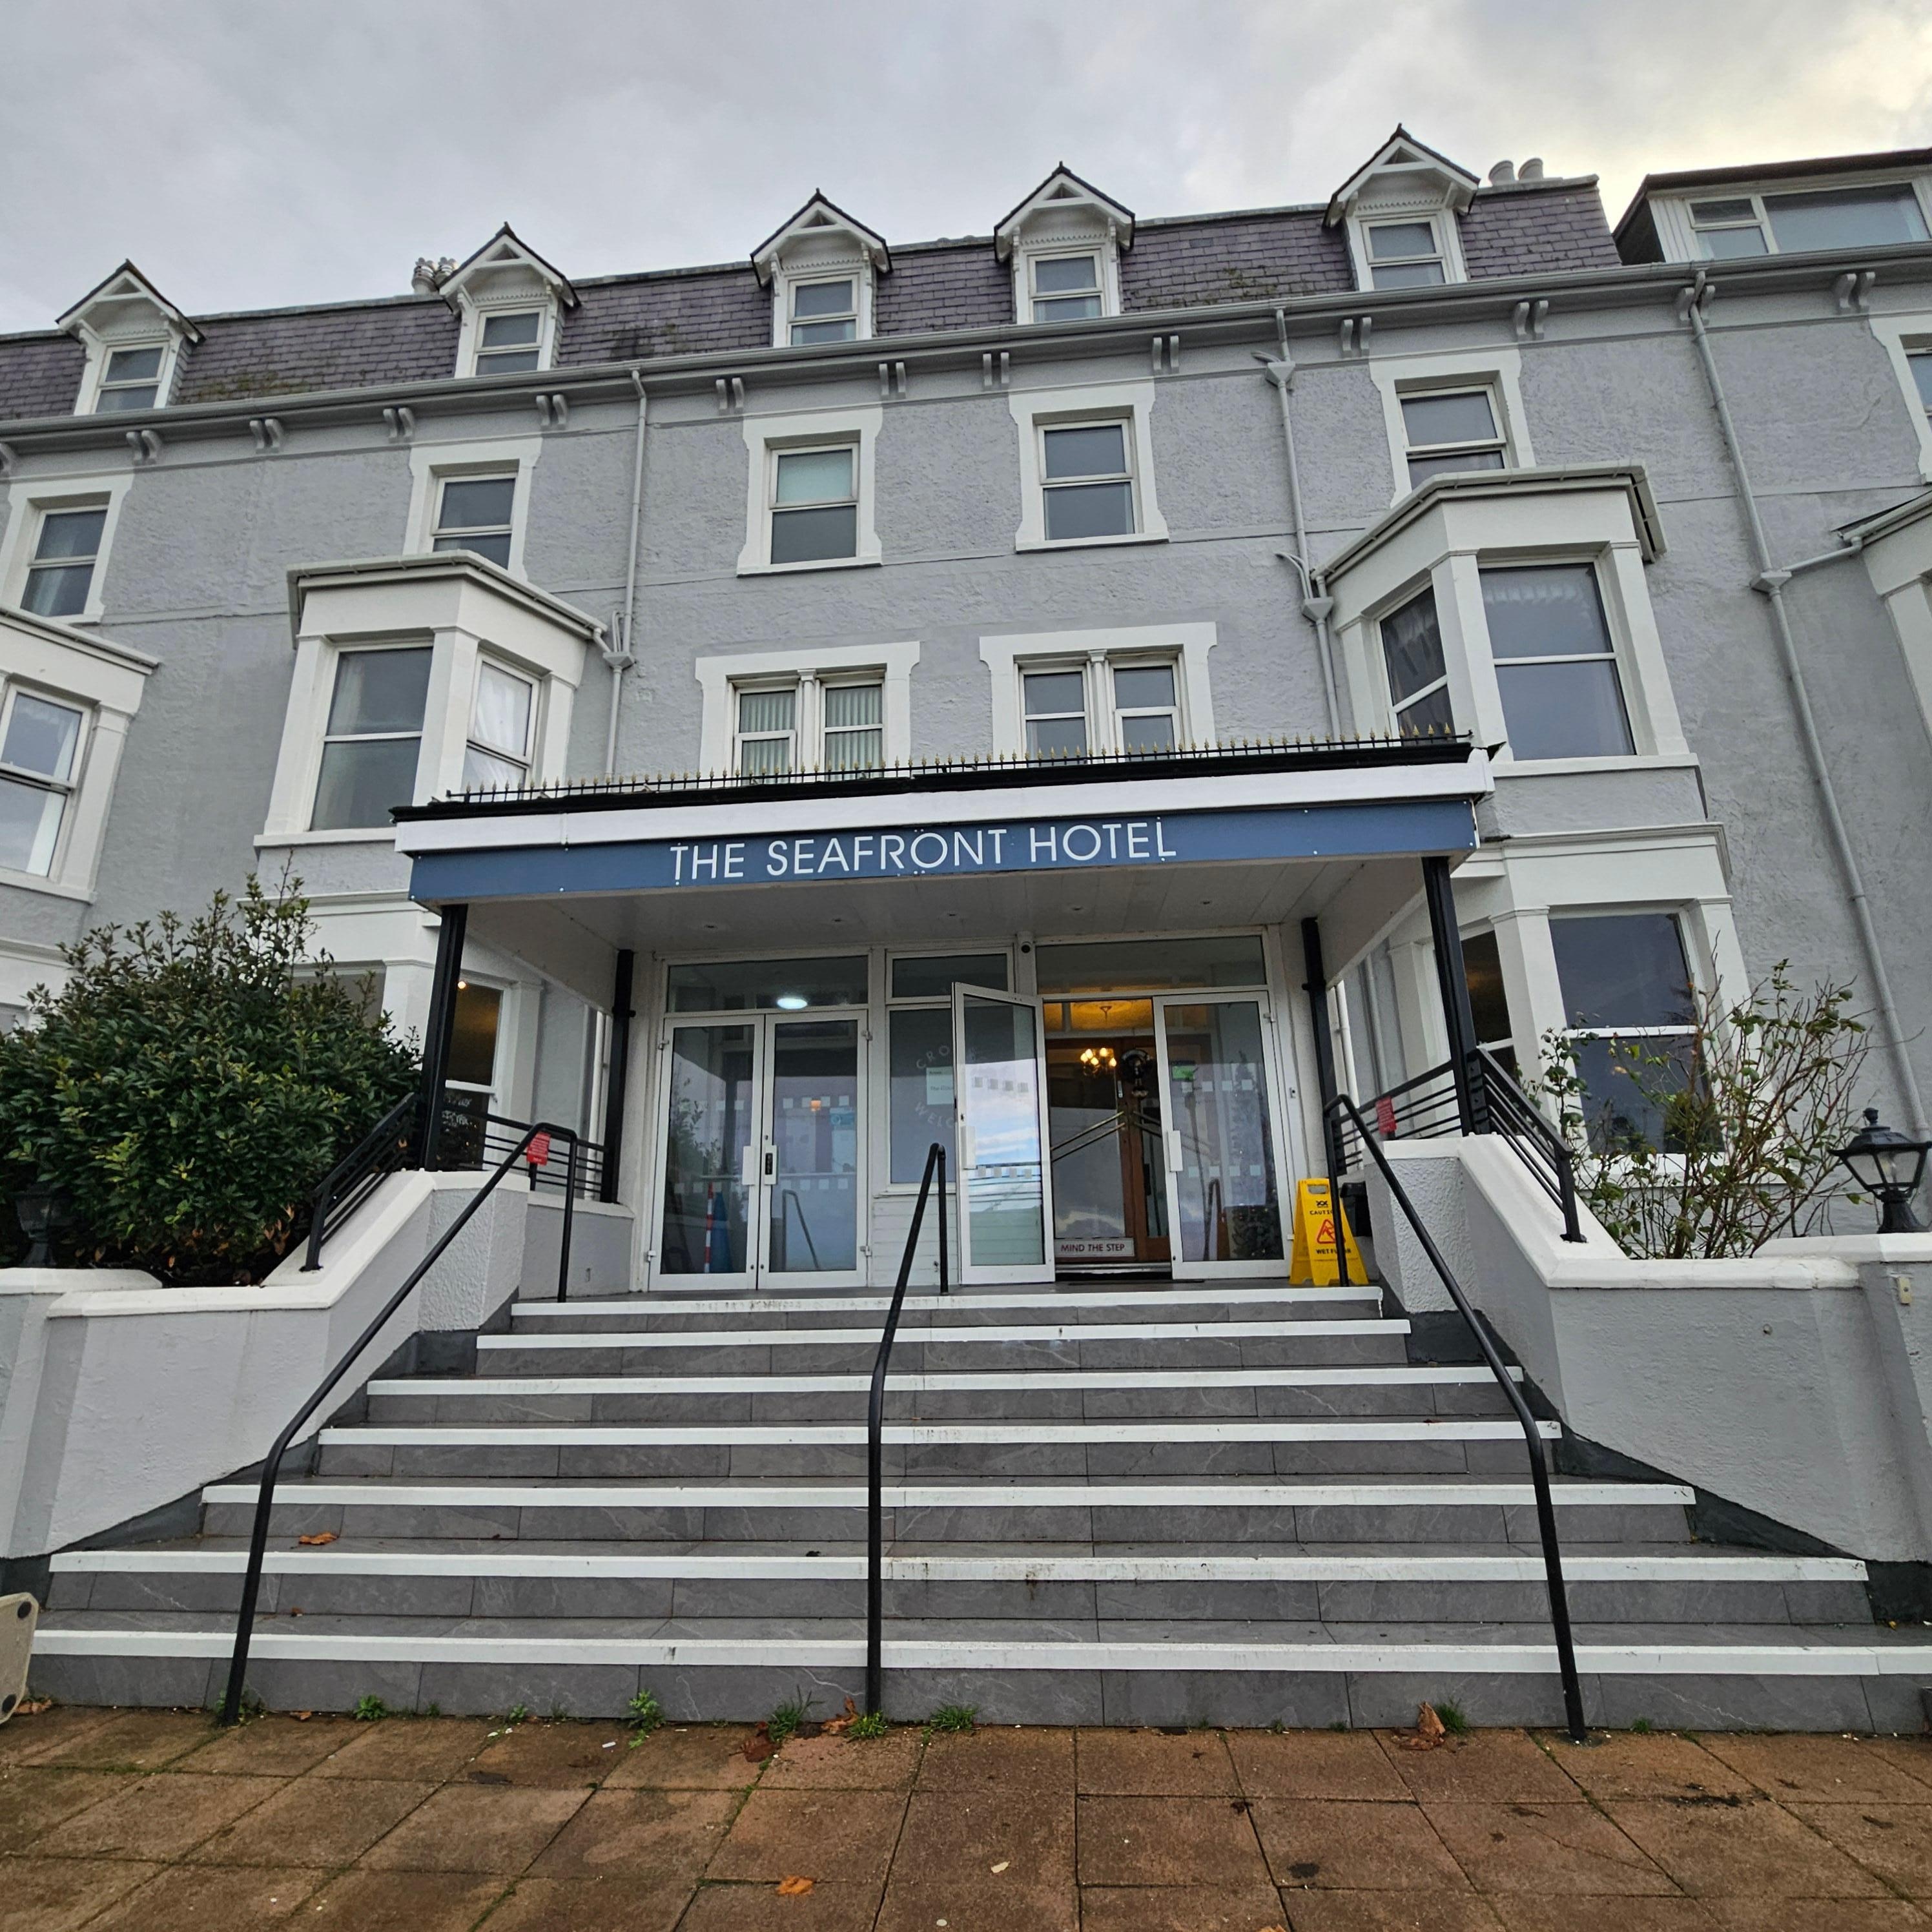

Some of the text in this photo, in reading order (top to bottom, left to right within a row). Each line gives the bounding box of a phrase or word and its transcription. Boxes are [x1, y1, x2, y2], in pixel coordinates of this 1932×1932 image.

[670, 821, 1177, 880] THE SEAFRONT HOTEL
[916, 1045, 950, 1069] CRO
[915, 1101, 954, 1129] WELC
[1060, 1243, 1125, 1252] MIND THE STEP
